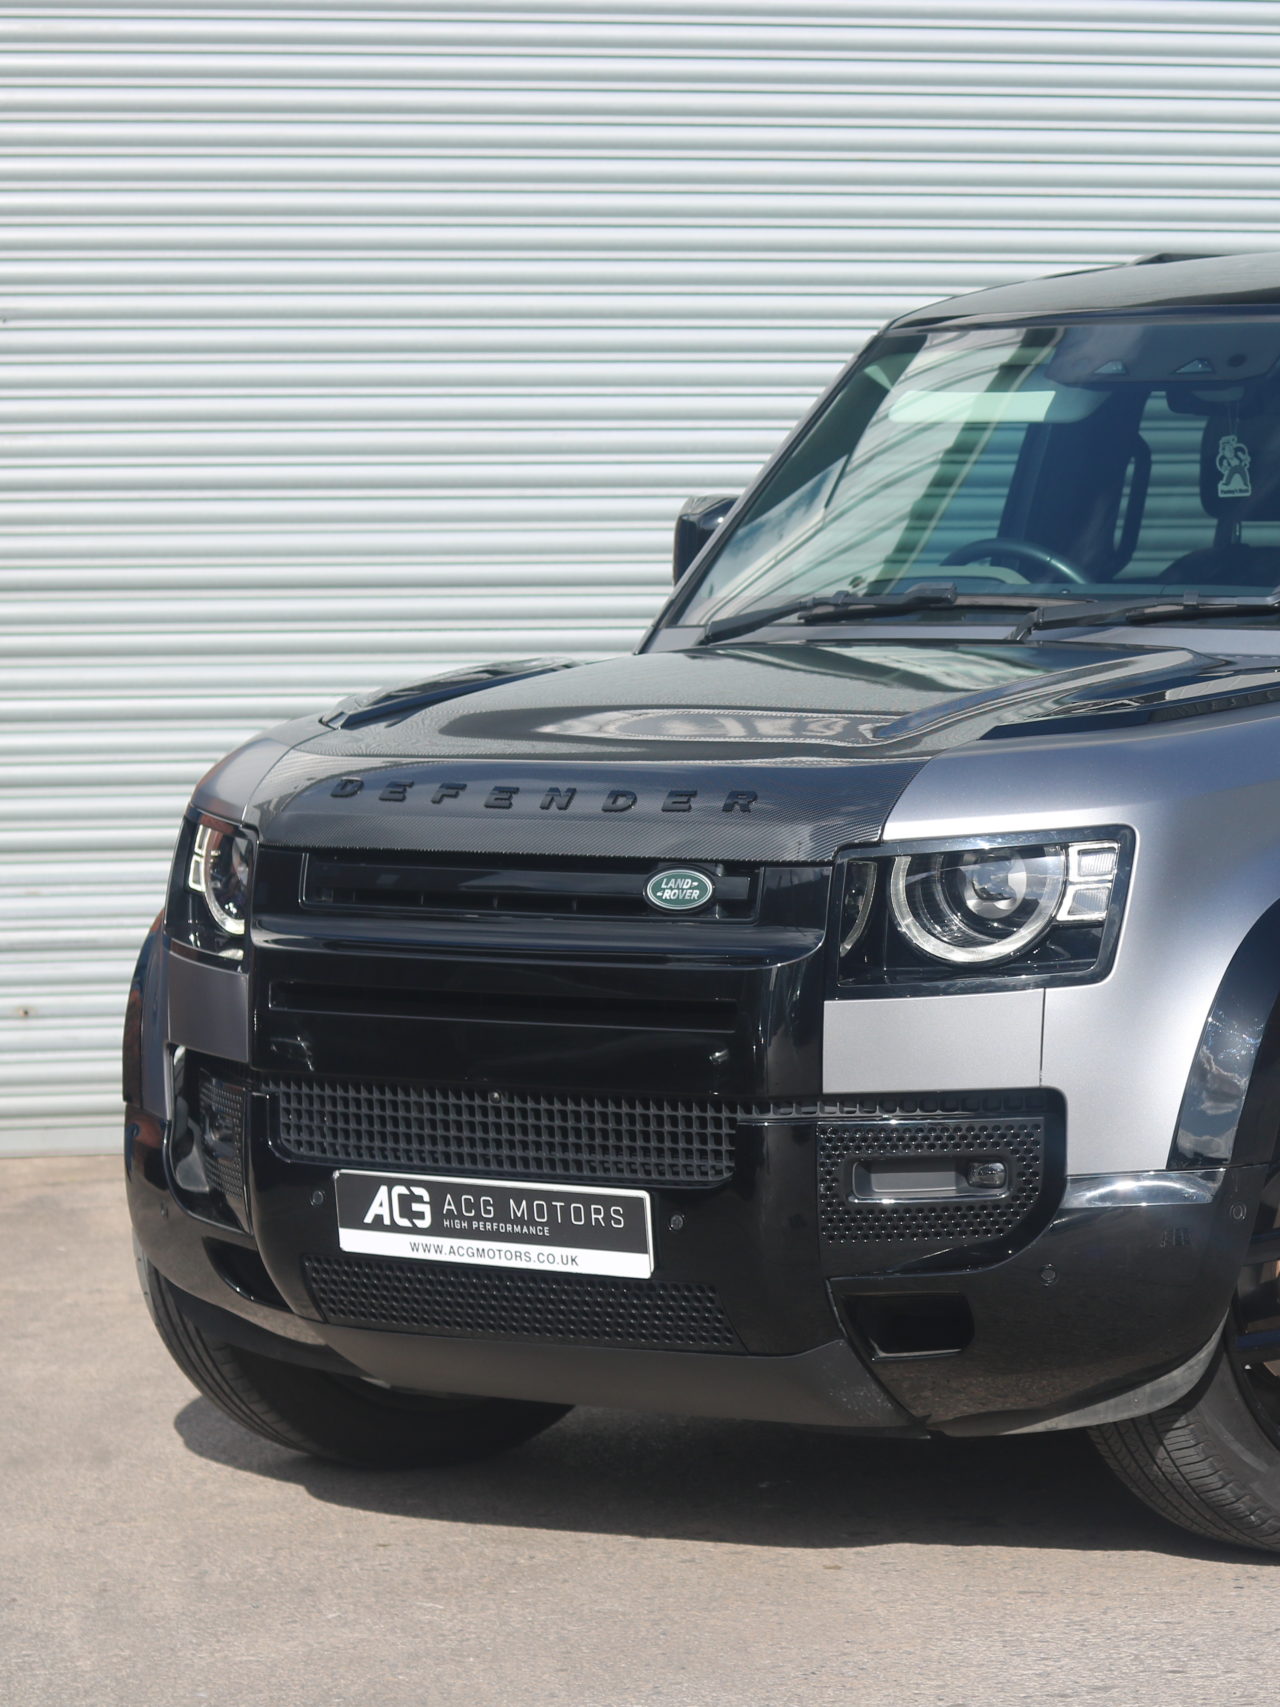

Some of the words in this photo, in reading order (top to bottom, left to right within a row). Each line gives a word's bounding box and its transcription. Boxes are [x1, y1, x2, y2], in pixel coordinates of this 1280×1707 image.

[329, 777, 758, 813] DEFENDER
[443, 1193, 494, 1218] ACG
[509, 1198, 625, 1228] MOTORS
[443, 1219, 468, 1230] HIGH
[472, 1221, 551, 1237] PERFORMANCE
[409, 1241, 579, 1266] WWW.ACGMOTORS.CO.UK
